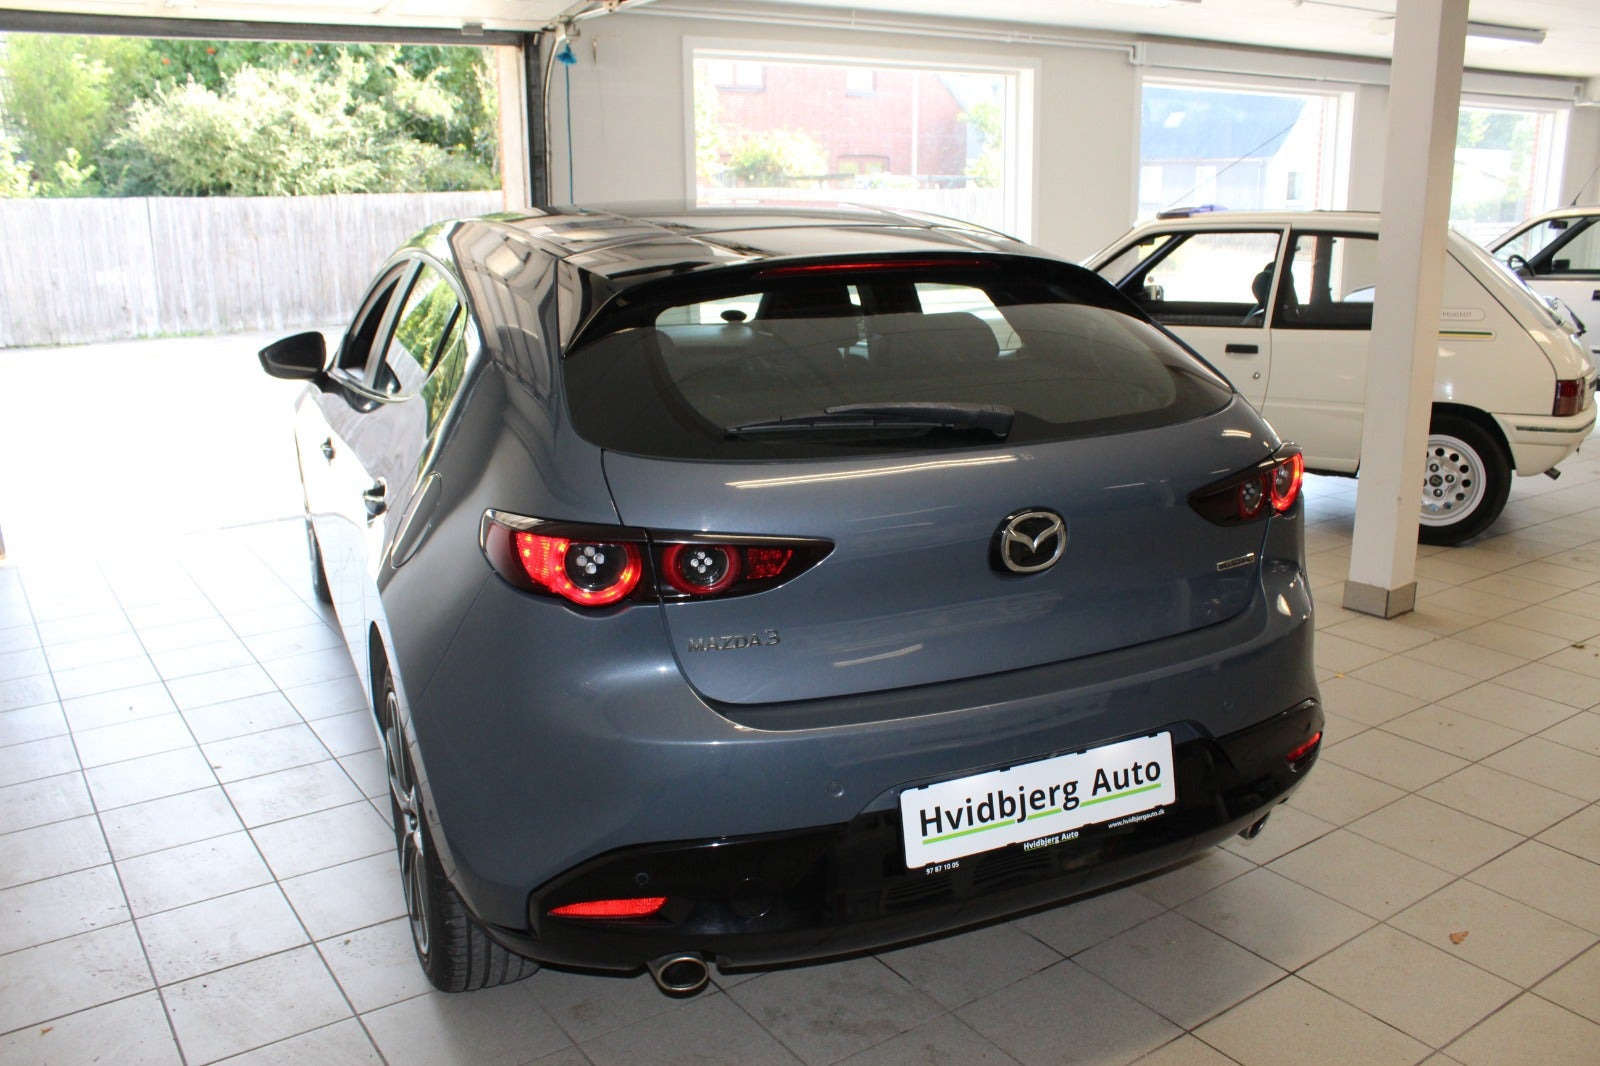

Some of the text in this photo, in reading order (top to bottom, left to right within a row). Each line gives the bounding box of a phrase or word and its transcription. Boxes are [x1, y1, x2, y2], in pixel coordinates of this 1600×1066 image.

[919, 760, 1162, 837] Hvidbjerg Auto
[1107, 809, 1165, 829] www.hvidbjergauto.dk
[1023, 829, 1079, 851] Hvidbjerg Auto
[944, 863, 951, 871] 10
